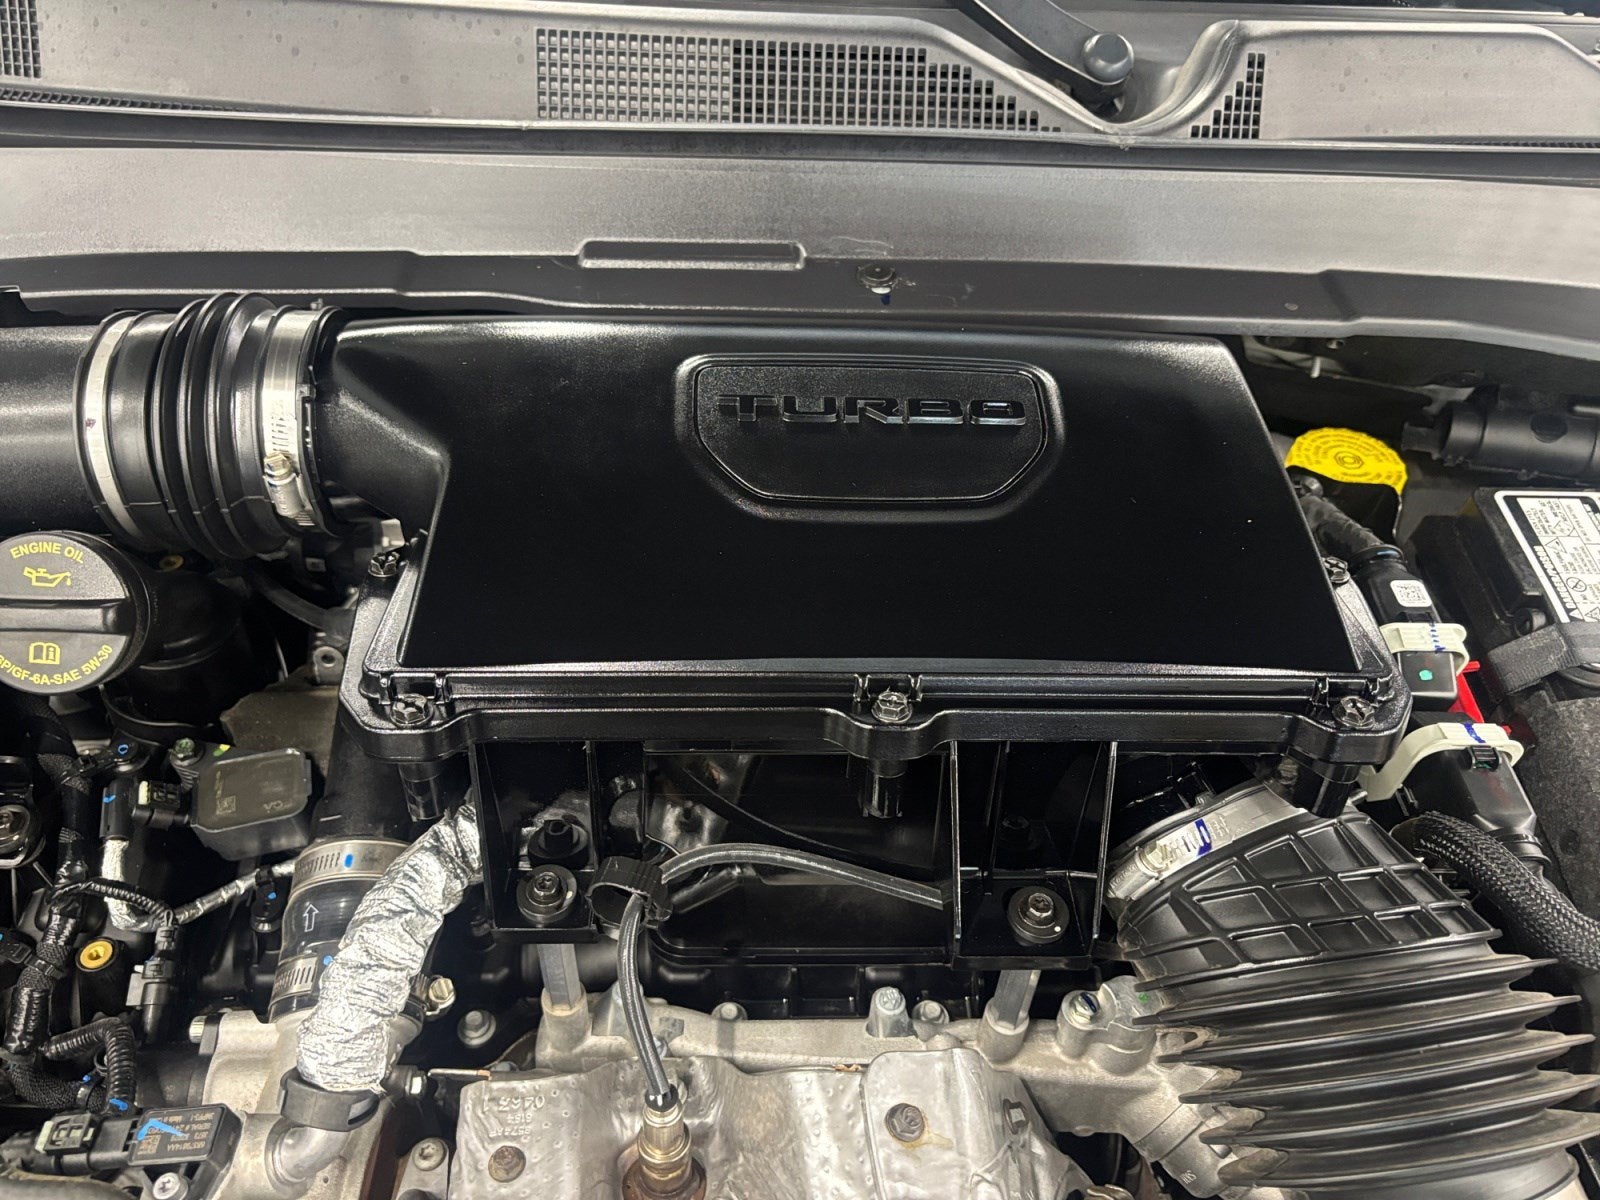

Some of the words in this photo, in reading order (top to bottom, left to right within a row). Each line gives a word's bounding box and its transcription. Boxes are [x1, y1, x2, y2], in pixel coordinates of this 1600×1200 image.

[716, 395, 1026, 425] TURBO
[10, 542, 62, 559] ENGINE
[64, 546, 85, 564] OIL
[82, 644, 113, 674] 5W-30
